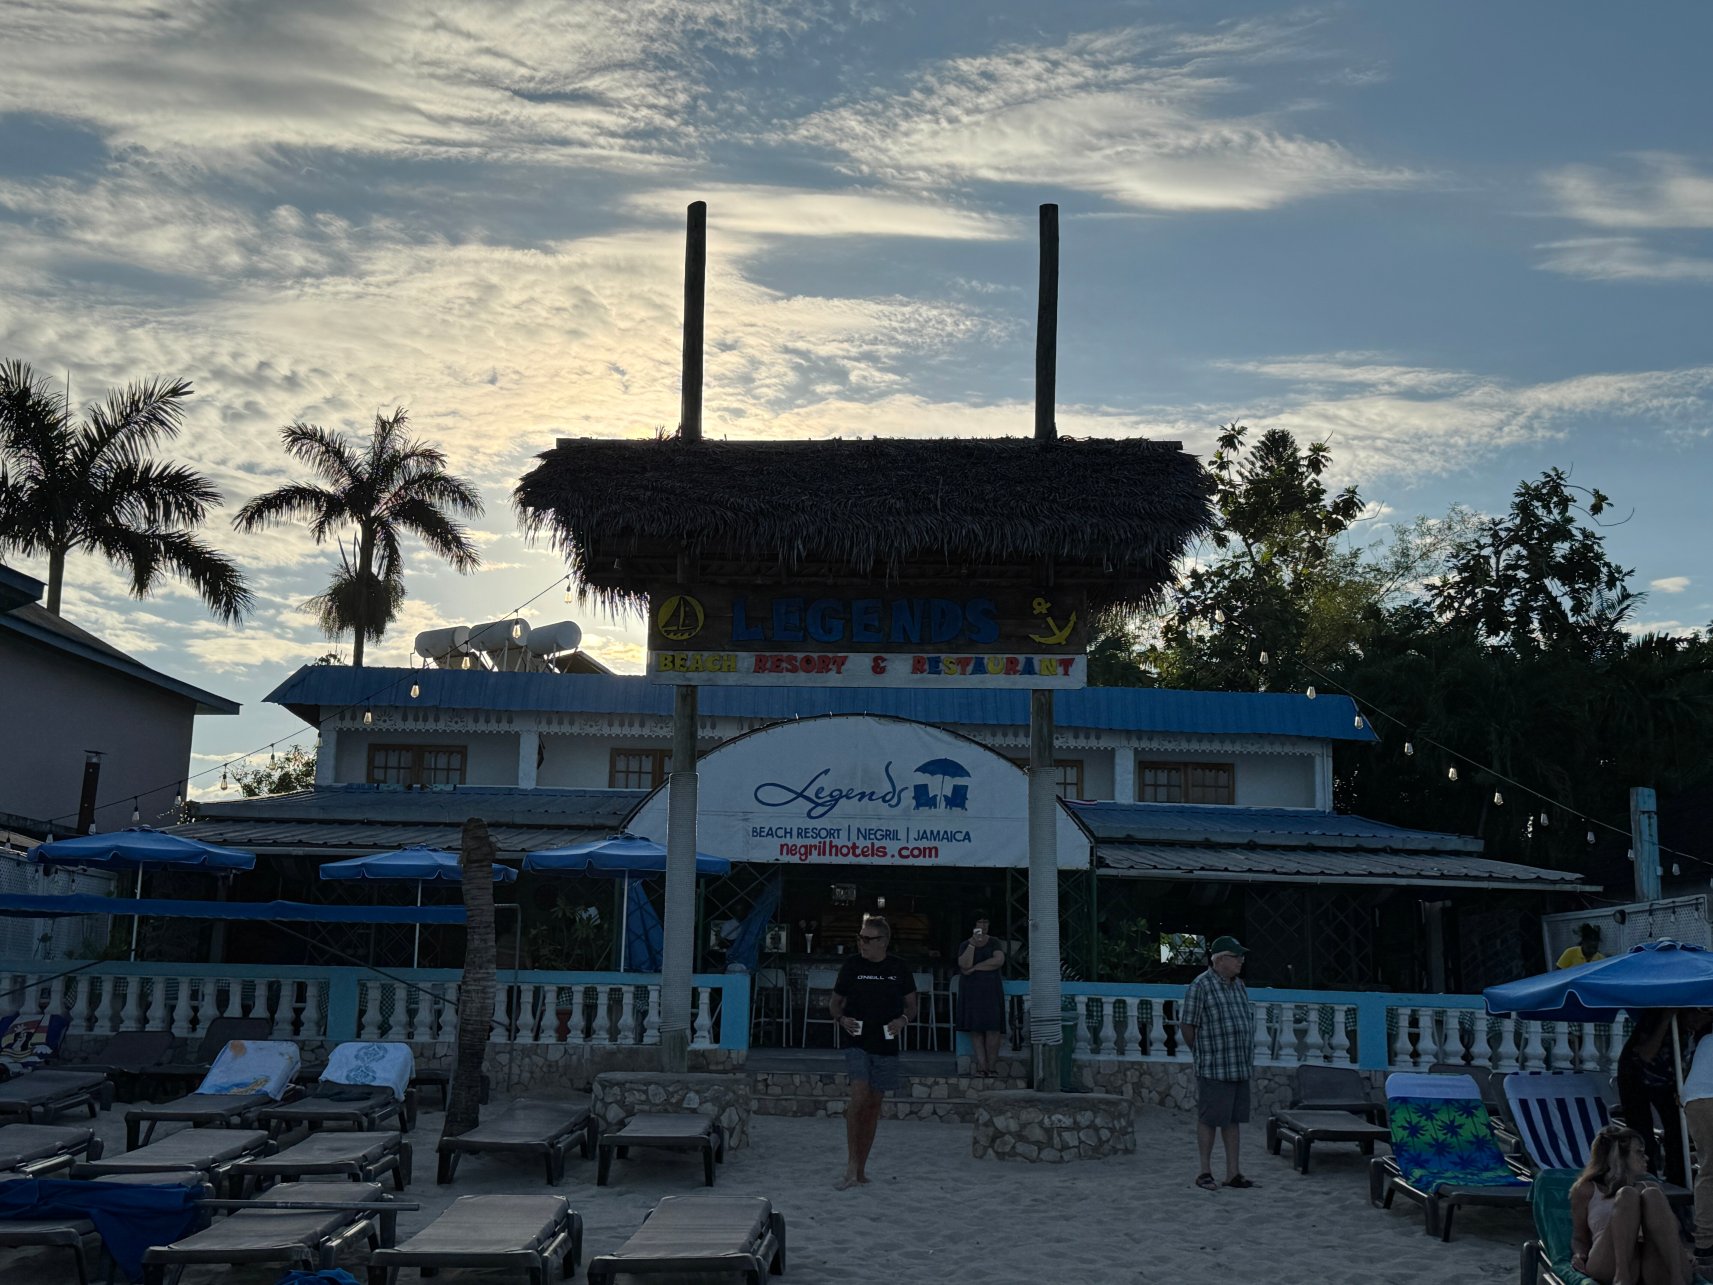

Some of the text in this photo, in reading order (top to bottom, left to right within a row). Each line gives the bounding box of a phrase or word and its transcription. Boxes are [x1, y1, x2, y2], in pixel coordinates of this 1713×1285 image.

[732, 596, 1000, 644] LEGENDS
[656, 653, 1076, 677] BEACH RESORT & RESTAURANT
[753, 760, 908, 820] Legends
[752, 826, 793, 839] BEACH
[796, 827, 842, 840] RESORT
[856, 827, 901, 841] NEGRIL
[913, 830, 972, 843] JAMAICA
